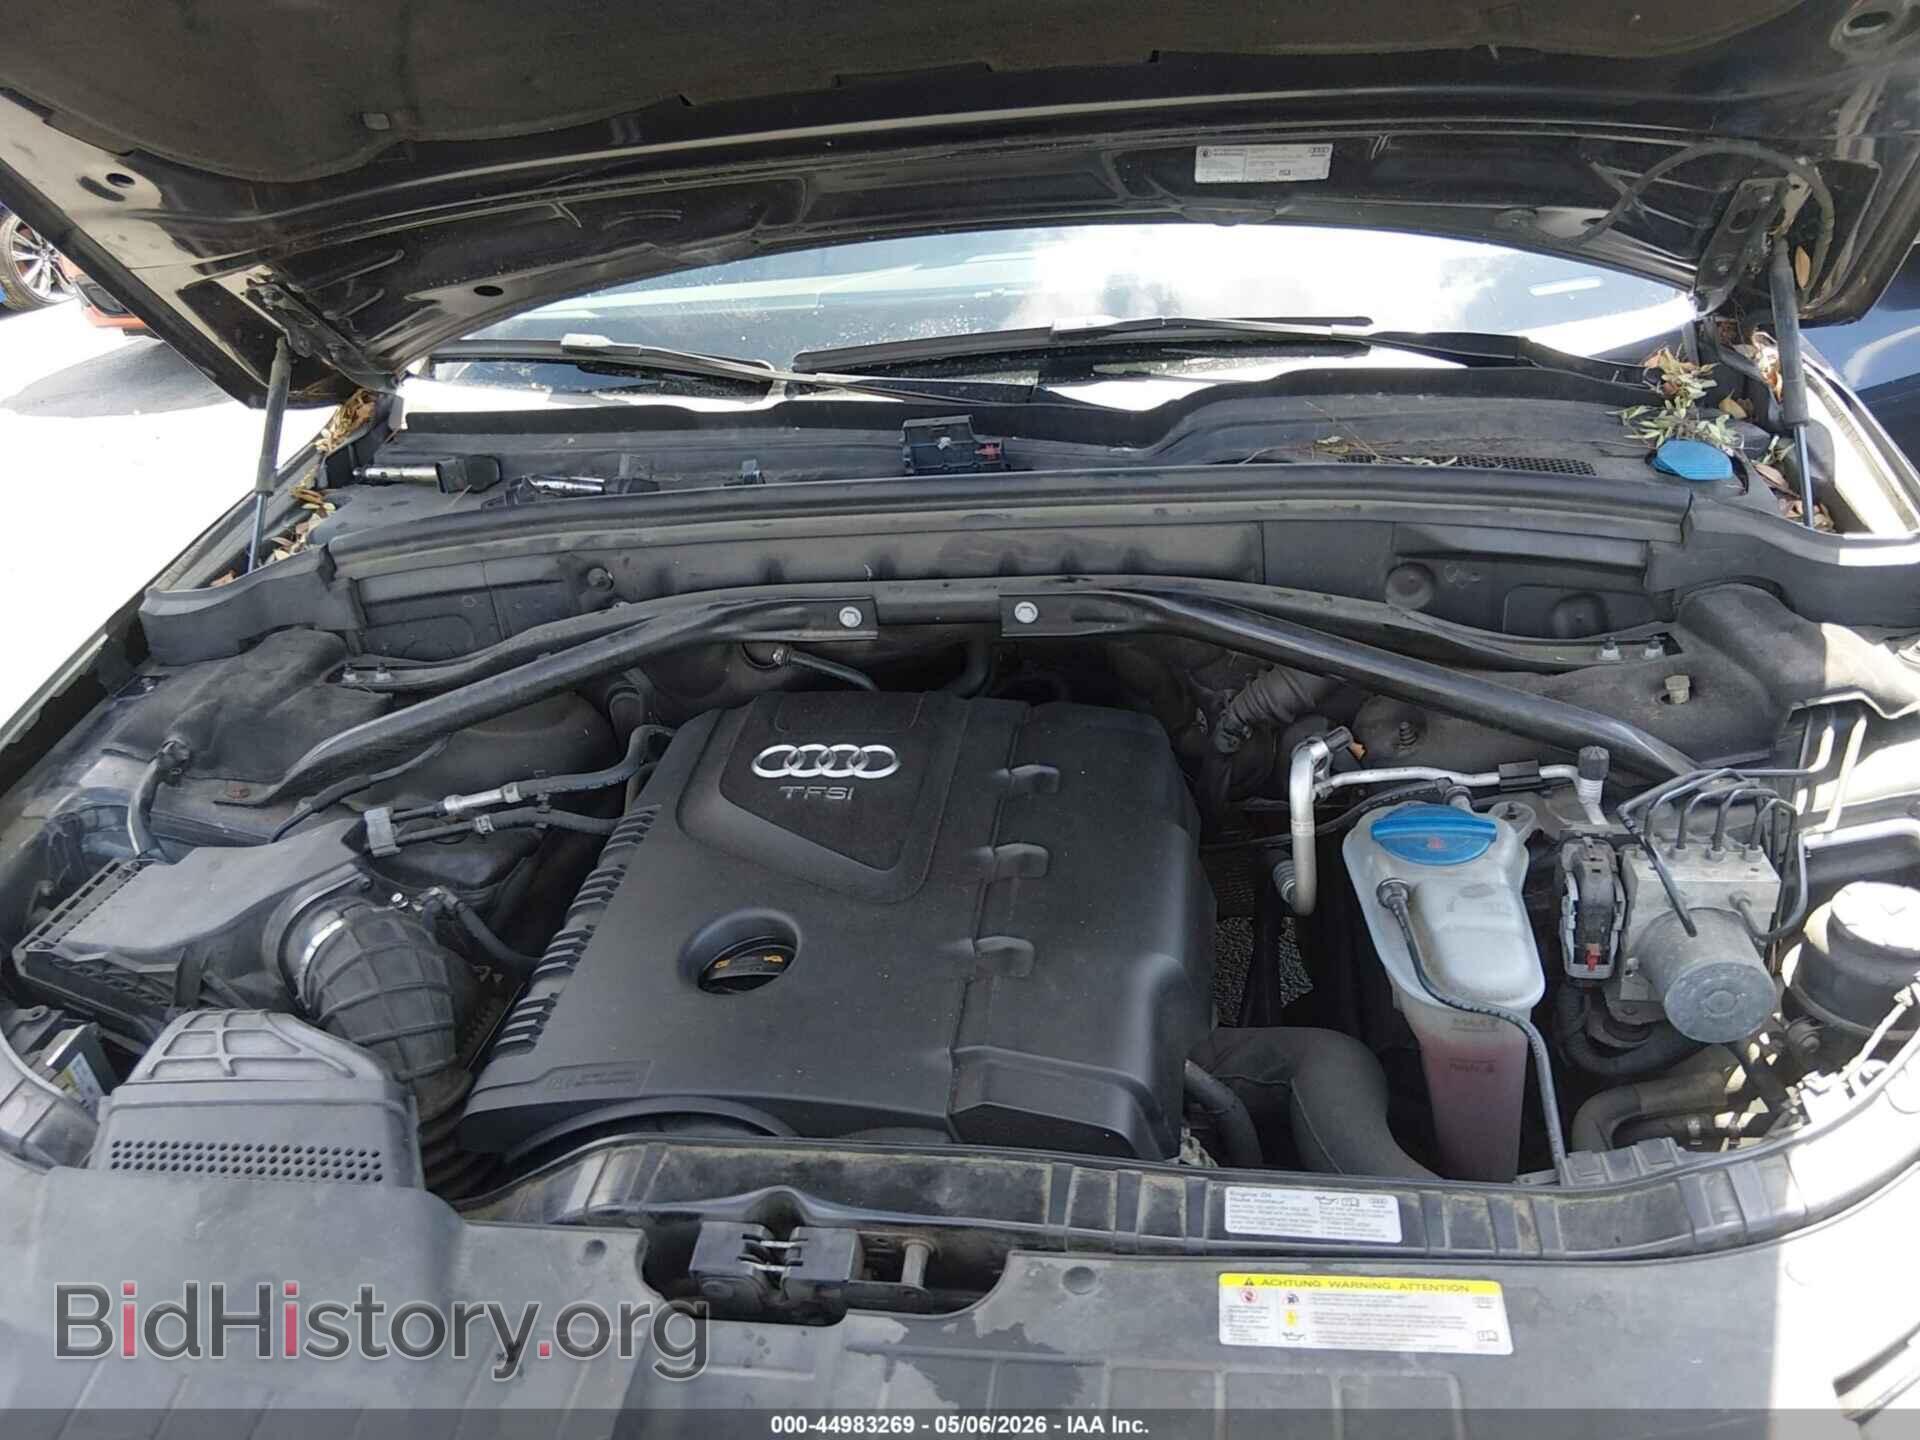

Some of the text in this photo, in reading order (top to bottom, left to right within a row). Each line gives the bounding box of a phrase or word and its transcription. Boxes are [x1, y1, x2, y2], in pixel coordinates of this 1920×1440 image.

[779, 785, 855, 801] TFSI
[1262, 1279, 1470, 1293] ACHTUNG WARNING ATTENTION
